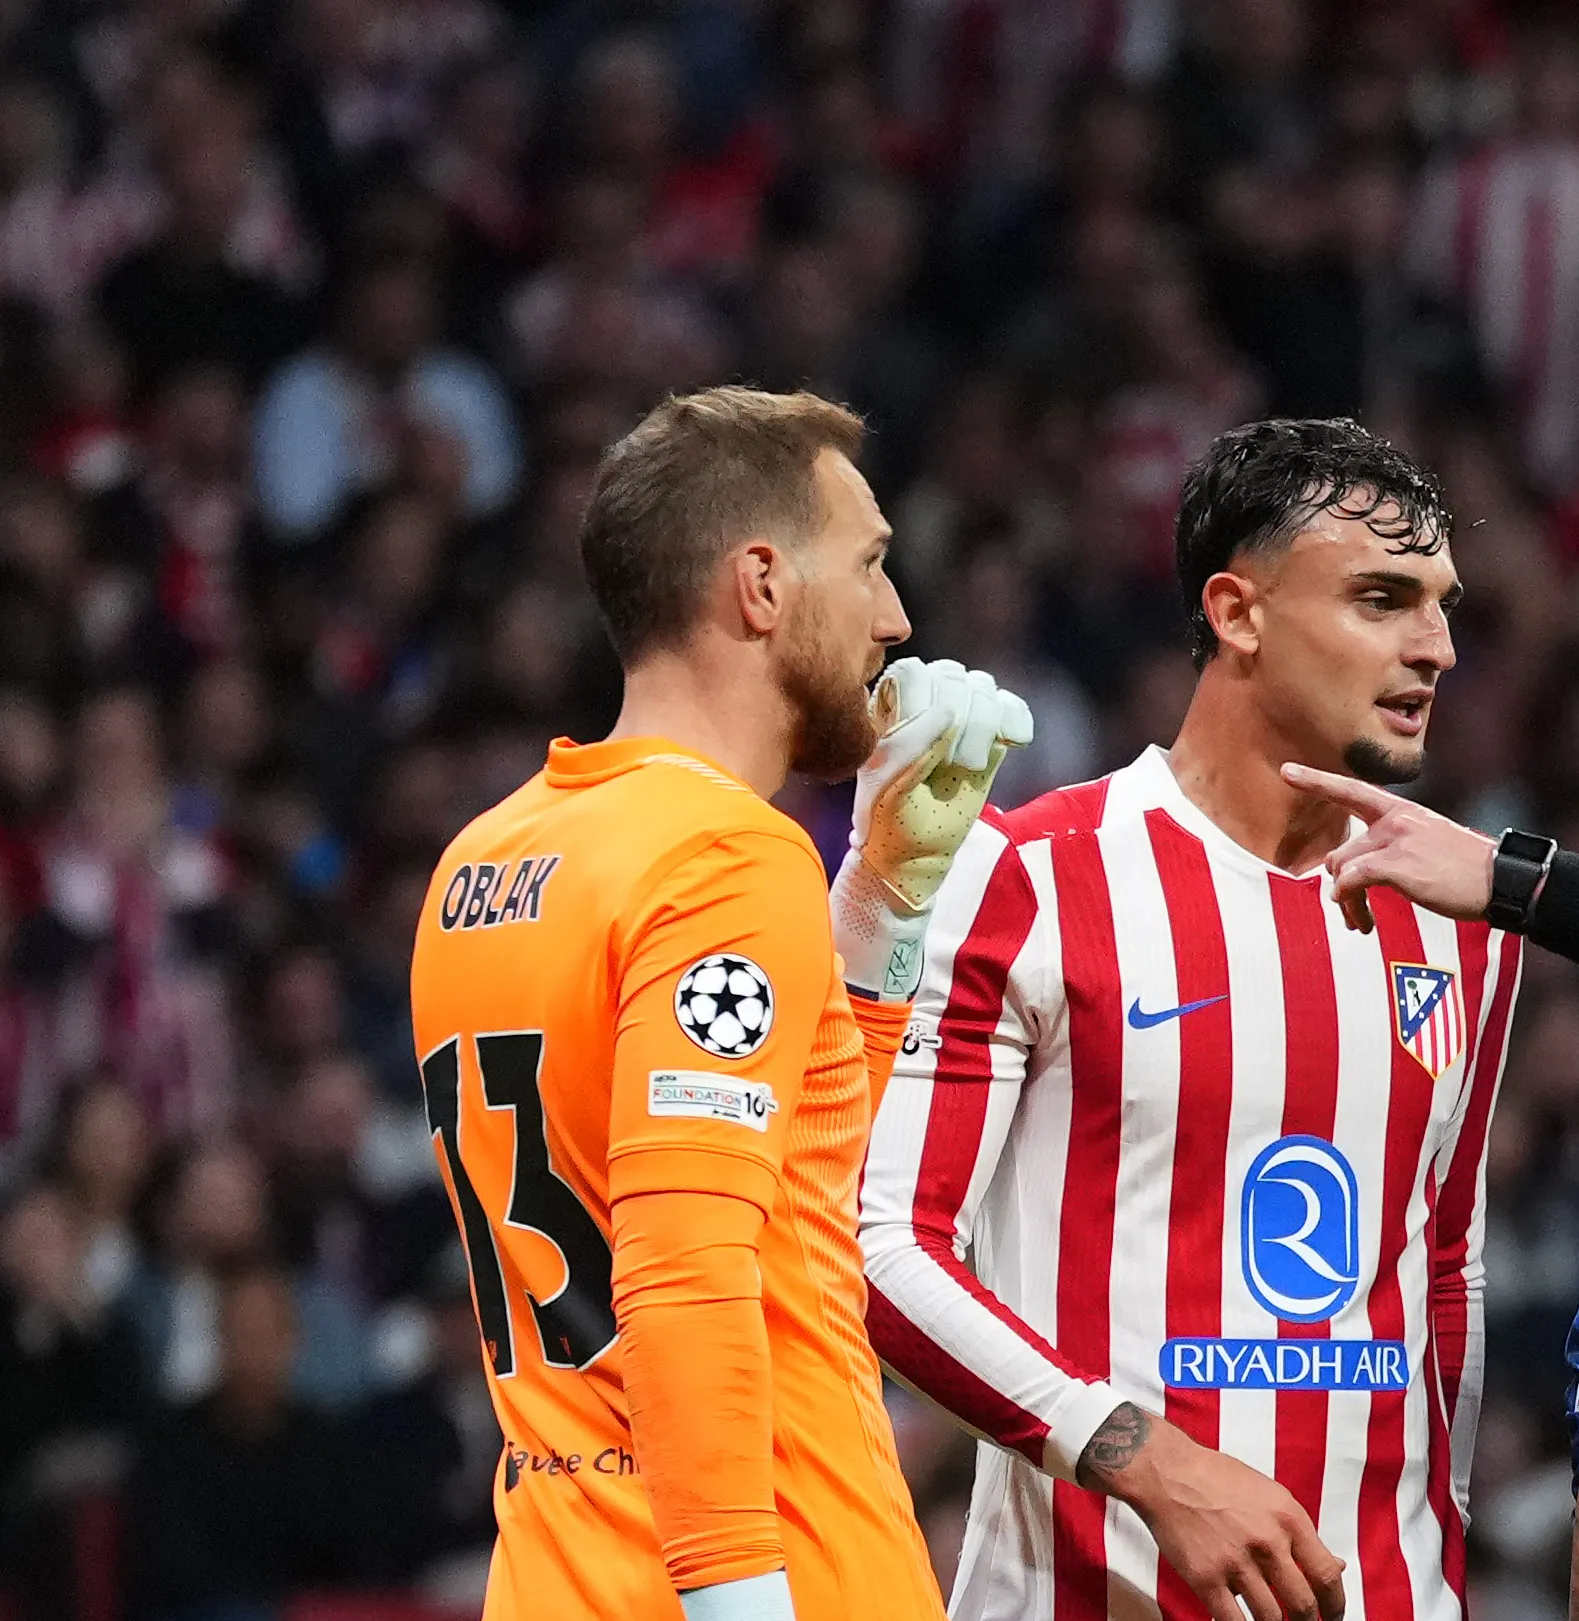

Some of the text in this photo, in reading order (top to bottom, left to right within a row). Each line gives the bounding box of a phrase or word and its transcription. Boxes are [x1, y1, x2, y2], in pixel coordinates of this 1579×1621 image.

[441, 855, 560, 932] OBLAK
[653, 1088, 741, 1107] FOUNDATION
[421, 1030, 620, 1378] 13
[1173, 1344, 1405, 1386] RIYADH AIR
